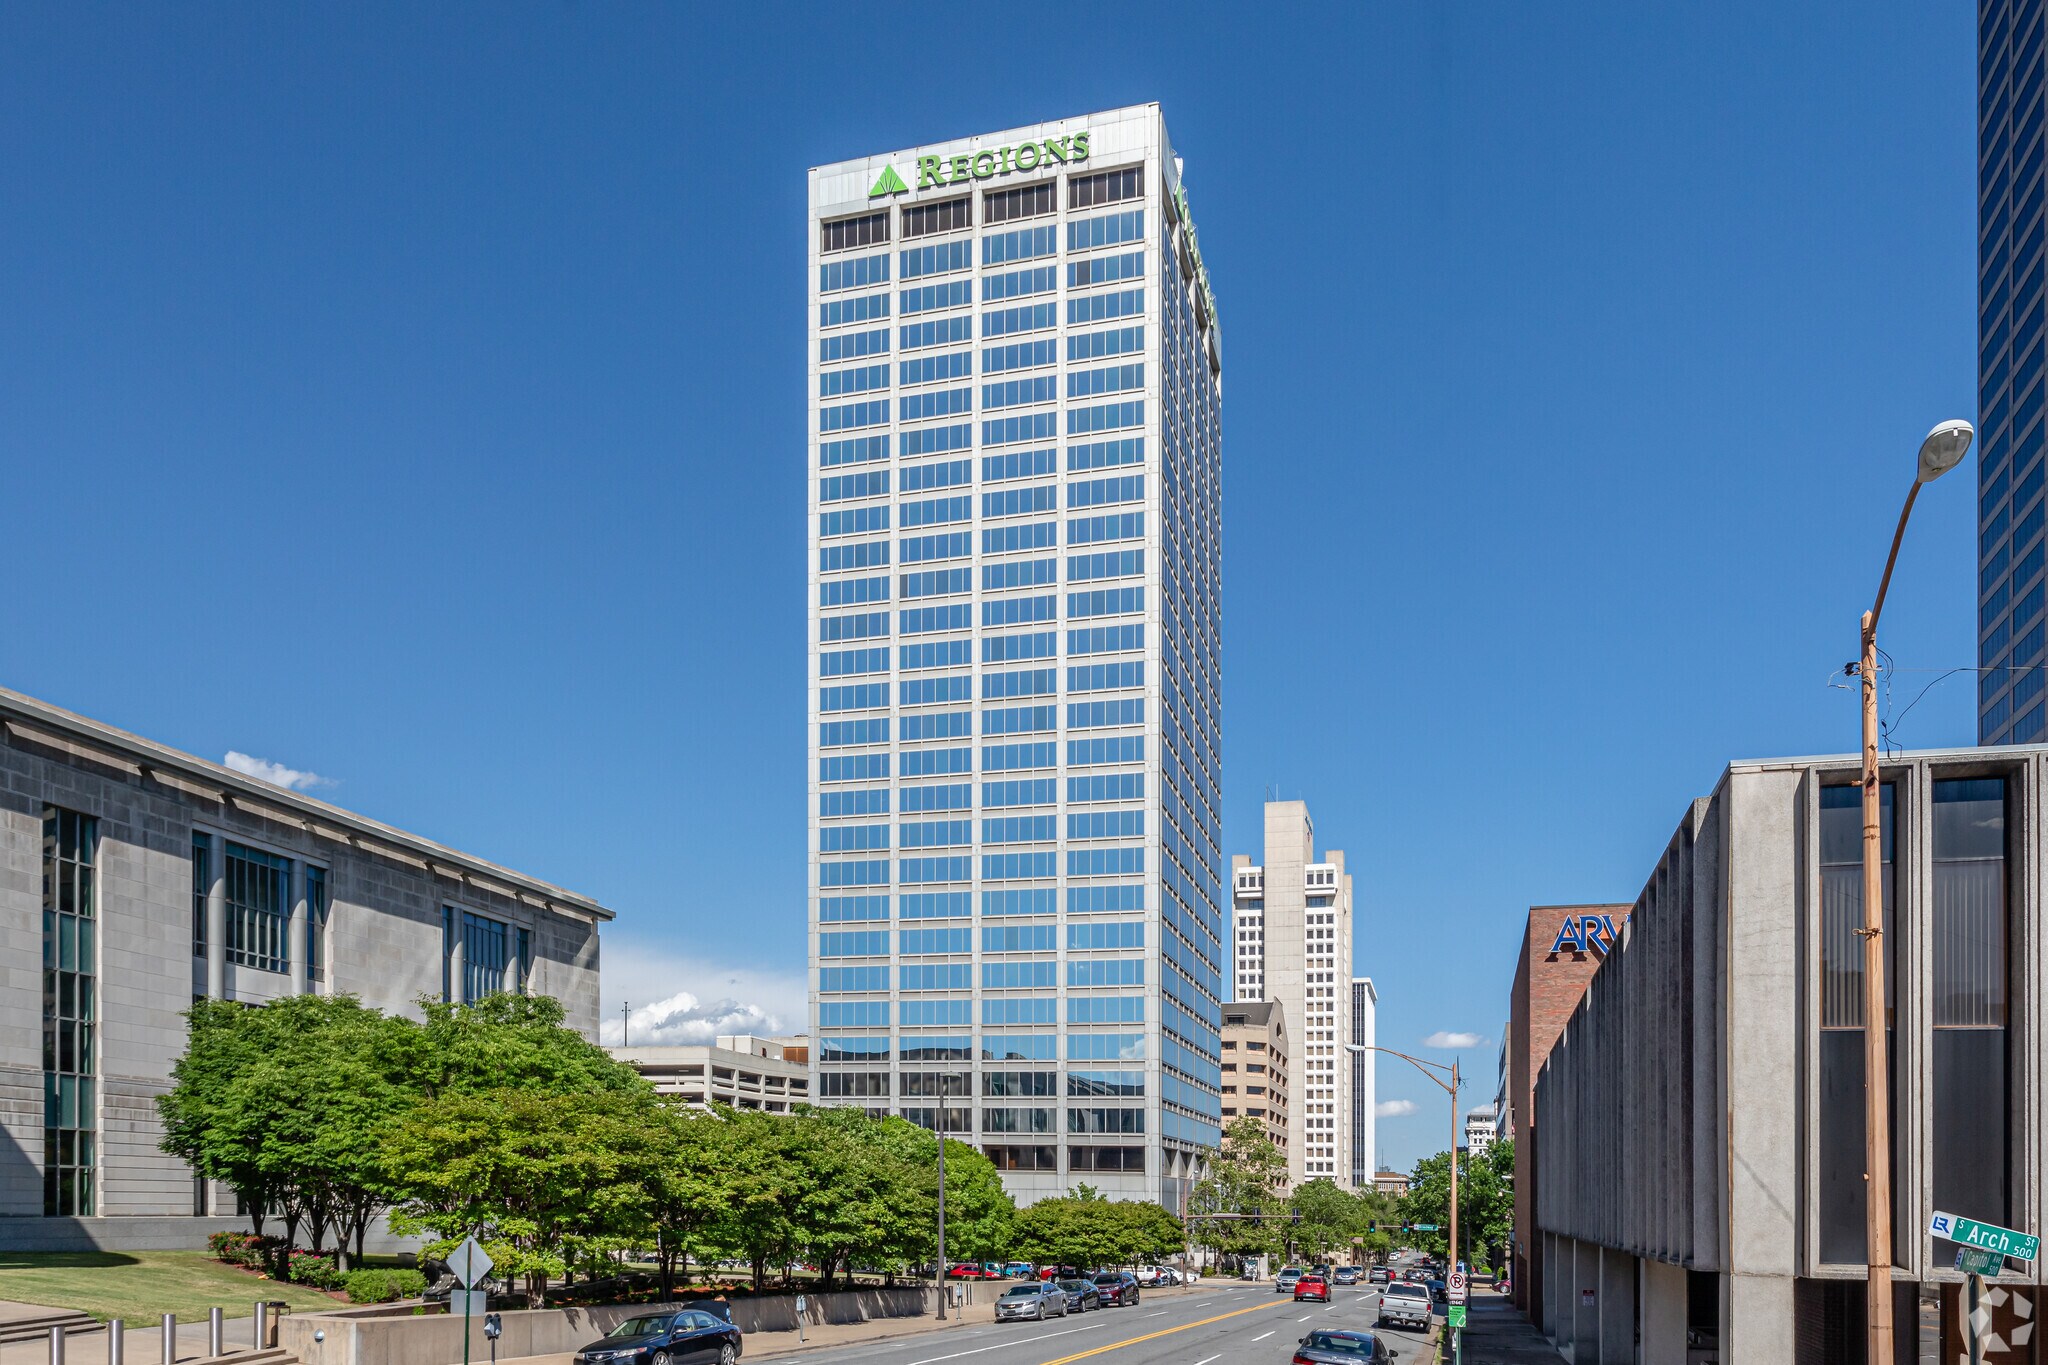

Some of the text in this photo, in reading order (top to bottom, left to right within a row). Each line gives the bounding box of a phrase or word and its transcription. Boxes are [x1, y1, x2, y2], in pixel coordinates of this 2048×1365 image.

[918, 131, 1089, 186] REGIONS
[1959, 1219, 2035, 1250] S Arch St
[2013, 1246, 2032, 1258] 500
